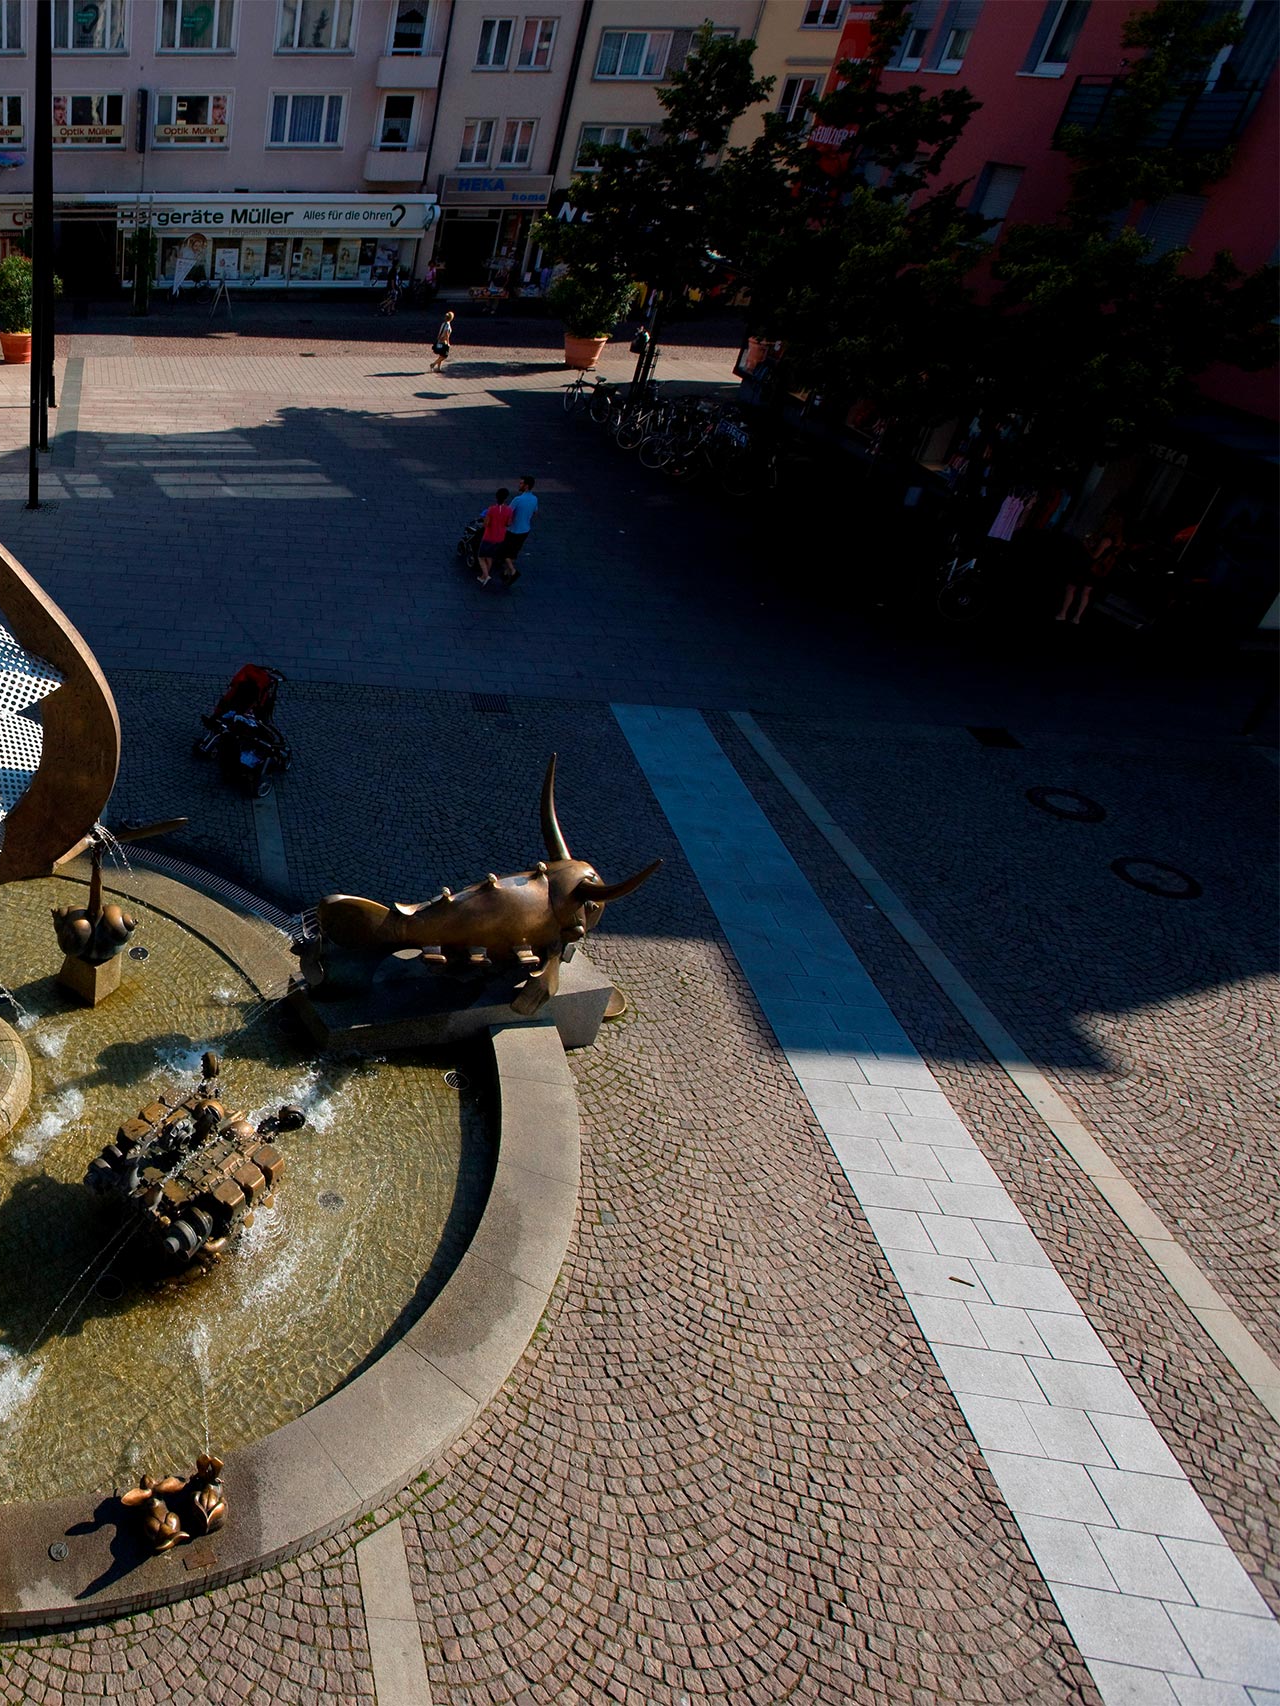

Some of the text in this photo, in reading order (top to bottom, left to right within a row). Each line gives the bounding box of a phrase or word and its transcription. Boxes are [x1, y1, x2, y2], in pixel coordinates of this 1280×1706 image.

[60, 127, 115, 137] Optik Müller
[164, 127, 219, 136] Optik Müller
[458, 178, 505, 191] HEKA
[512, 192, 546, 201] home
[231, 208, 294, 224] Müller
[303, 211, 393, 220] Alles für die Ohren
